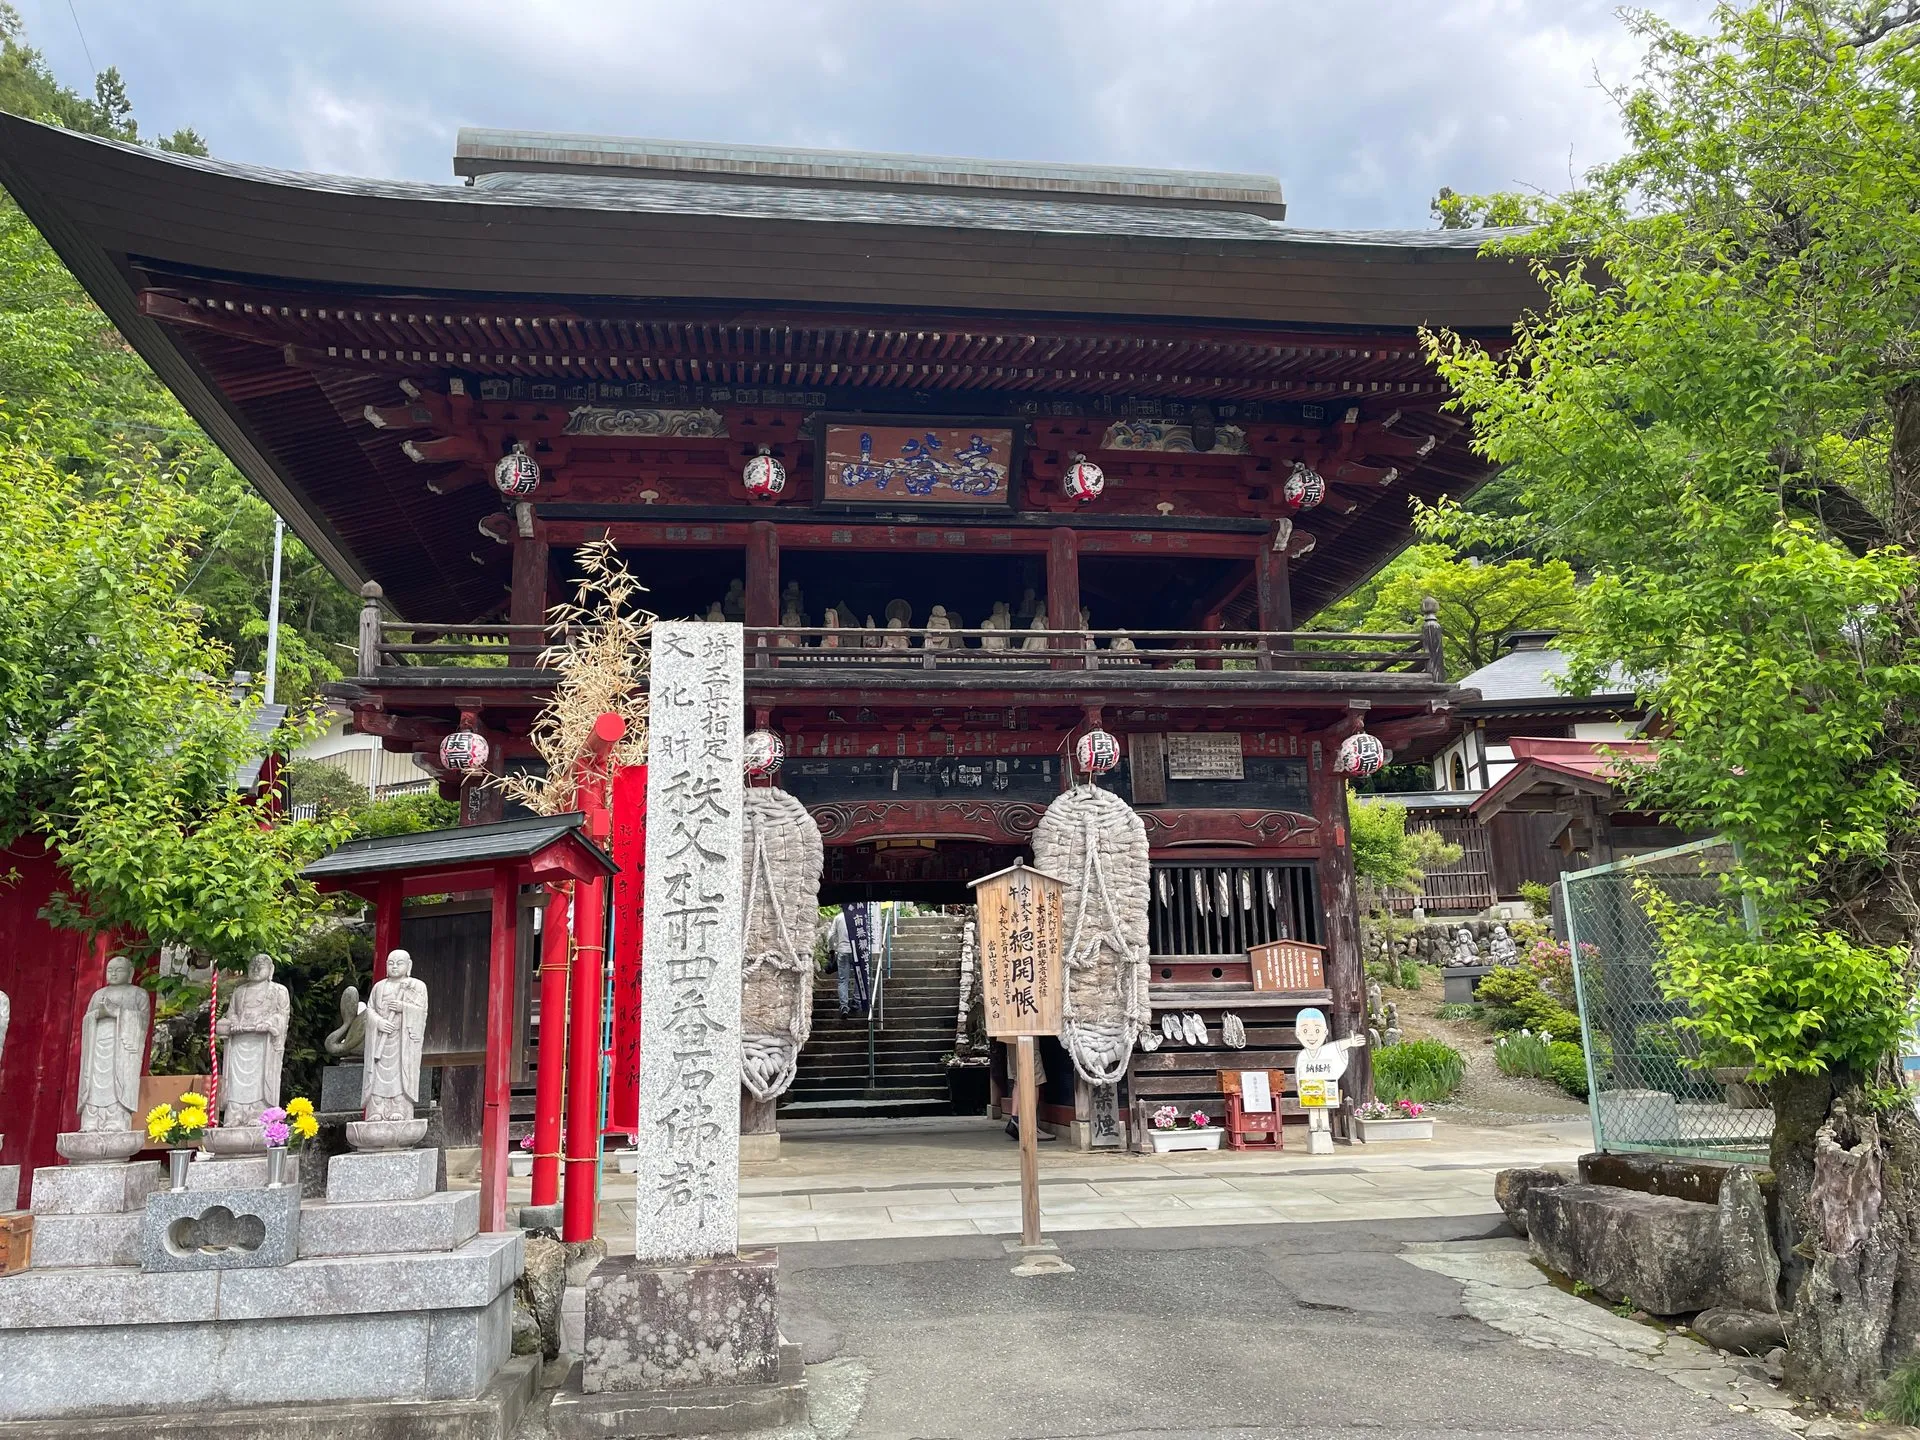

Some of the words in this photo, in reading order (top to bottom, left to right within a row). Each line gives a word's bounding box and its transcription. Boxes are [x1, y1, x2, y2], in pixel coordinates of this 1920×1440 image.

[657, 632, 695, 763] 文化財
[698, 632, 736, 764] 埼玉県指定
[1091, 732, 1115, 769] 開扉
[1356, 735, 1380, 772] 開扉
[654, 764, 731, 1229] 秩父札所四番石佛群
[1092, 1083, 1119, 1138] 禁煙
